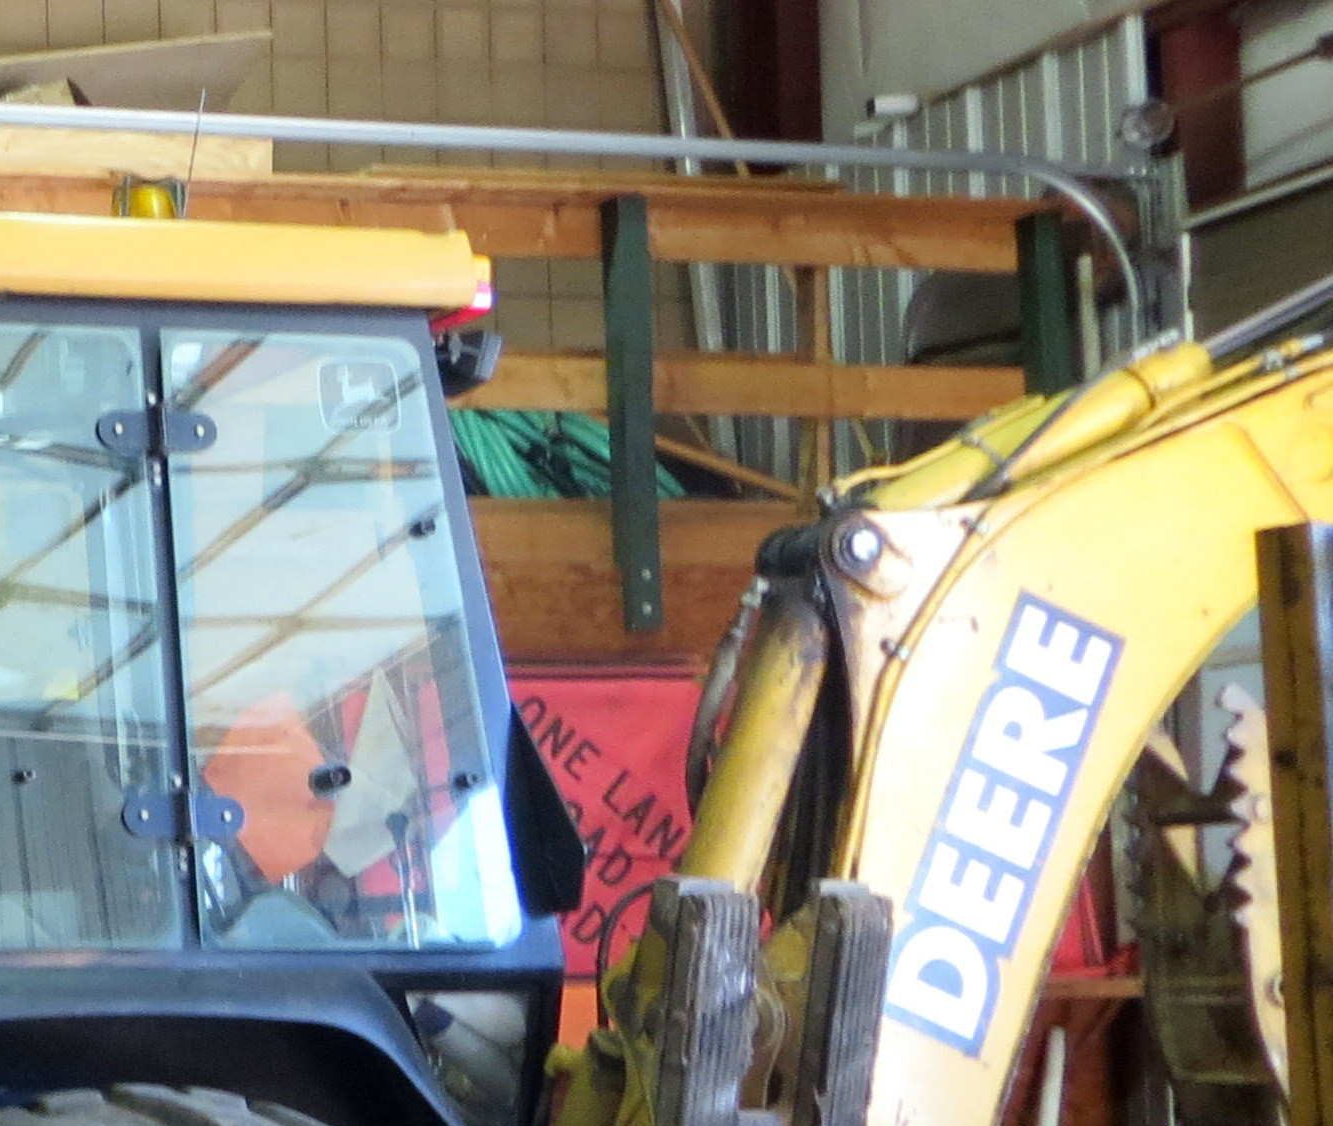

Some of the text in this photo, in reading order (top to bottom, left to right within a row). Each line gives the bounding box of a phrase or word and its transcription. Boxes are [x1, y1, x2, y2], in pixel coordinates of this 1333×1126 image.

[520, 696, 686, 859] ONE LAN
[885, 600, 1117, 1045] DEERE
